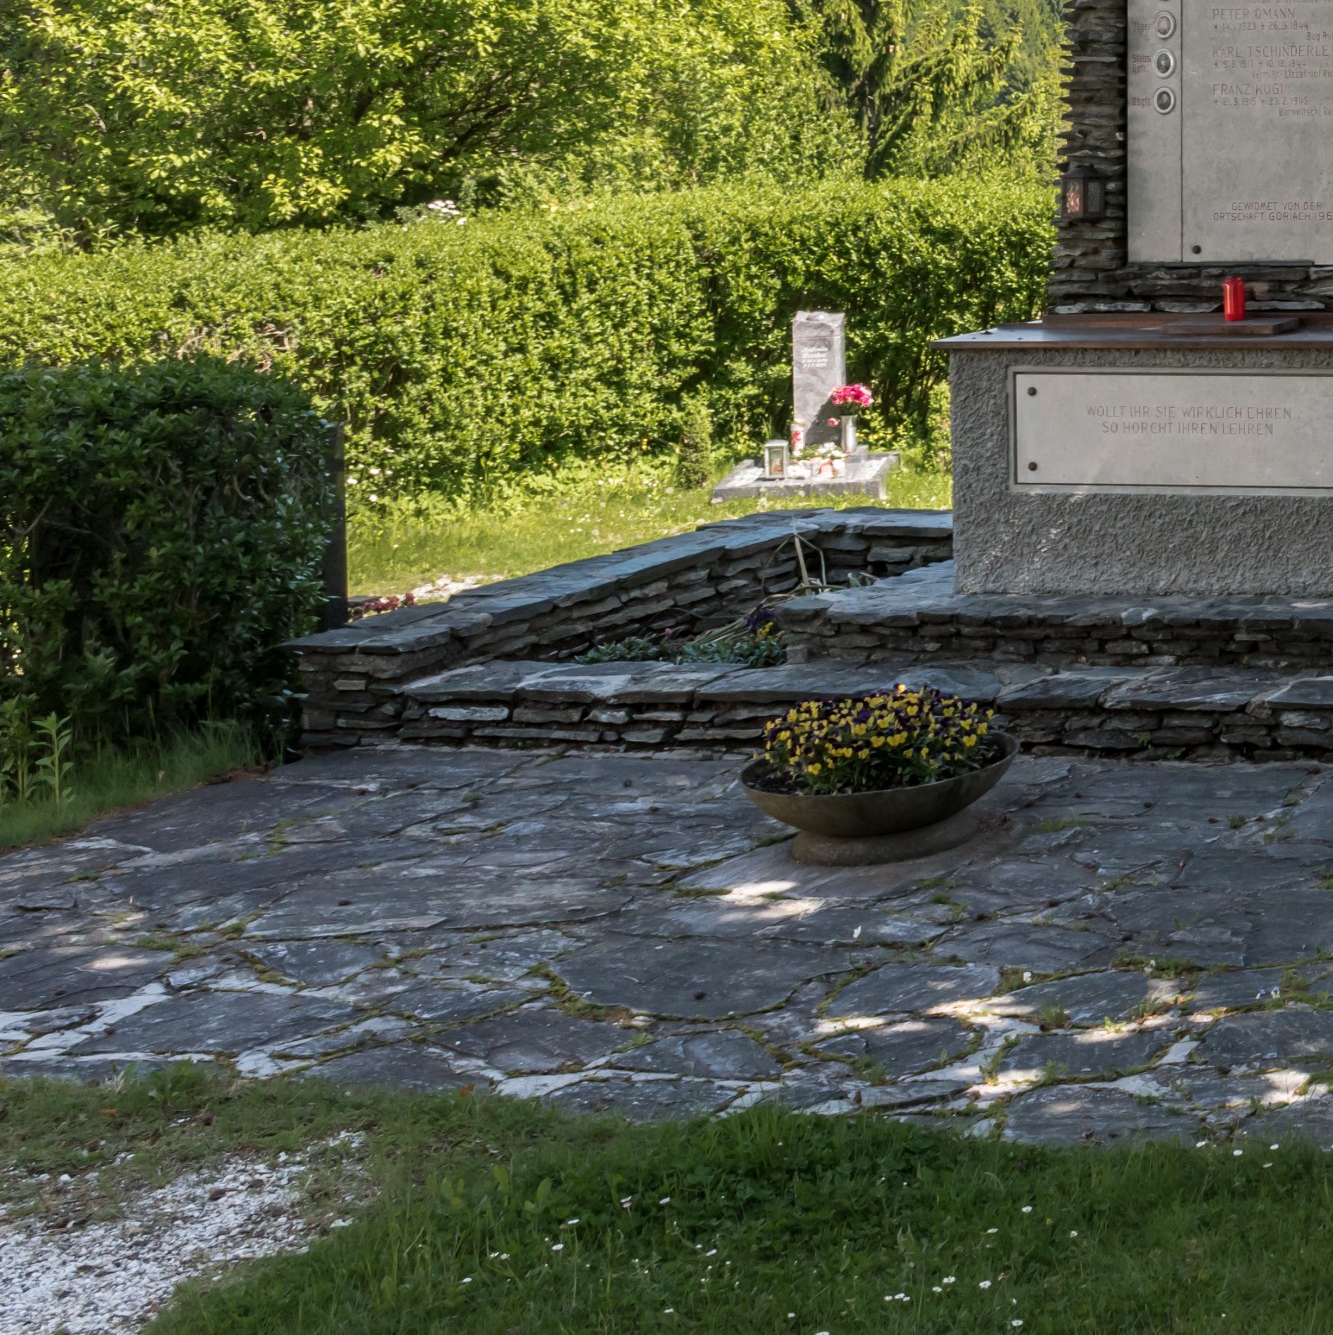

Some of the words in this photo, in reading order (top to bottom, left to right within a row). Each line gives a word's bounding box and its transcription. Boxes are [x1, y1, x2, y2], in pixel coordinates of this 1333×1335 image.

[1212, 8, 1250, 20] PETER
[1254, 7, 1296, 20] OMANN
[1212, 45, 1243, 58] KARL
[1247, 44, 1330, 58] TSCHINDERLE
[1212, 83, 1251, 96] FRANZ
[1231, 201, 1278, 211] GEWIDMET
[1282, 201, 1300, 211] VON
[1303, 201, 1322, 211] DER
[1213, 212, 1265, 221] ORTSCHAFT
[1087, 405, 1125, 418] WOLLT
[1129, 405, 1150, 418] IHR
[1155, 406, 1176, 418] SIE
[1181, 406, 1243, 419] WIRKLICH
[1247, 406, 1292, 420] EHREN
[1102, 421, 1119, 434] SO
[1123, 421, 1173, 435] HORCHT
[1178, 422, 1218, 435] IHREN
[1222, 422, 1274, 435] LEHREN
